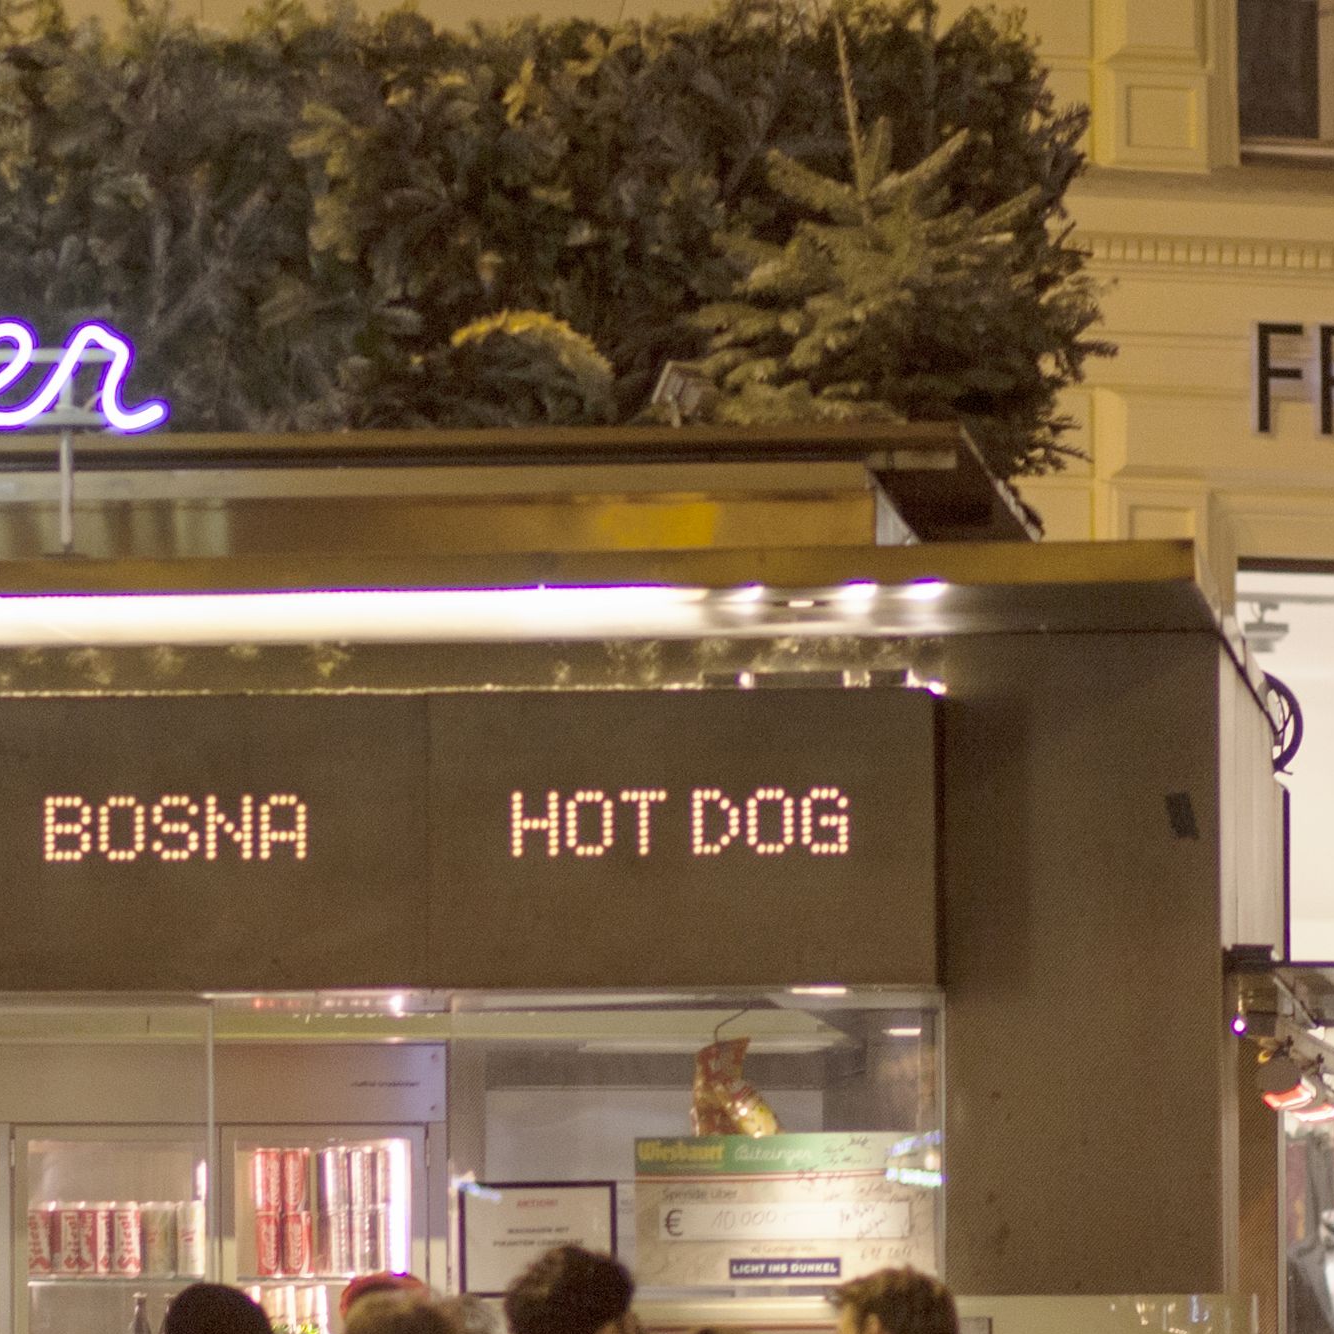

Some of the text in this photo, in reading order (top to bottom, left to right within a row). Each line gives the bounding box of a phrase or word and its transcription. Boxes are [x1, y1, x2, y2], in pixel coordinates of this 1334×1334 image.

[43, 793, 309, 862] BOSNA
[510, 786, 850, 858] HOT DOG
[732, 1263, 766, 1274] LICHT
[791, 1262, 837, 1273] DUNKEL
